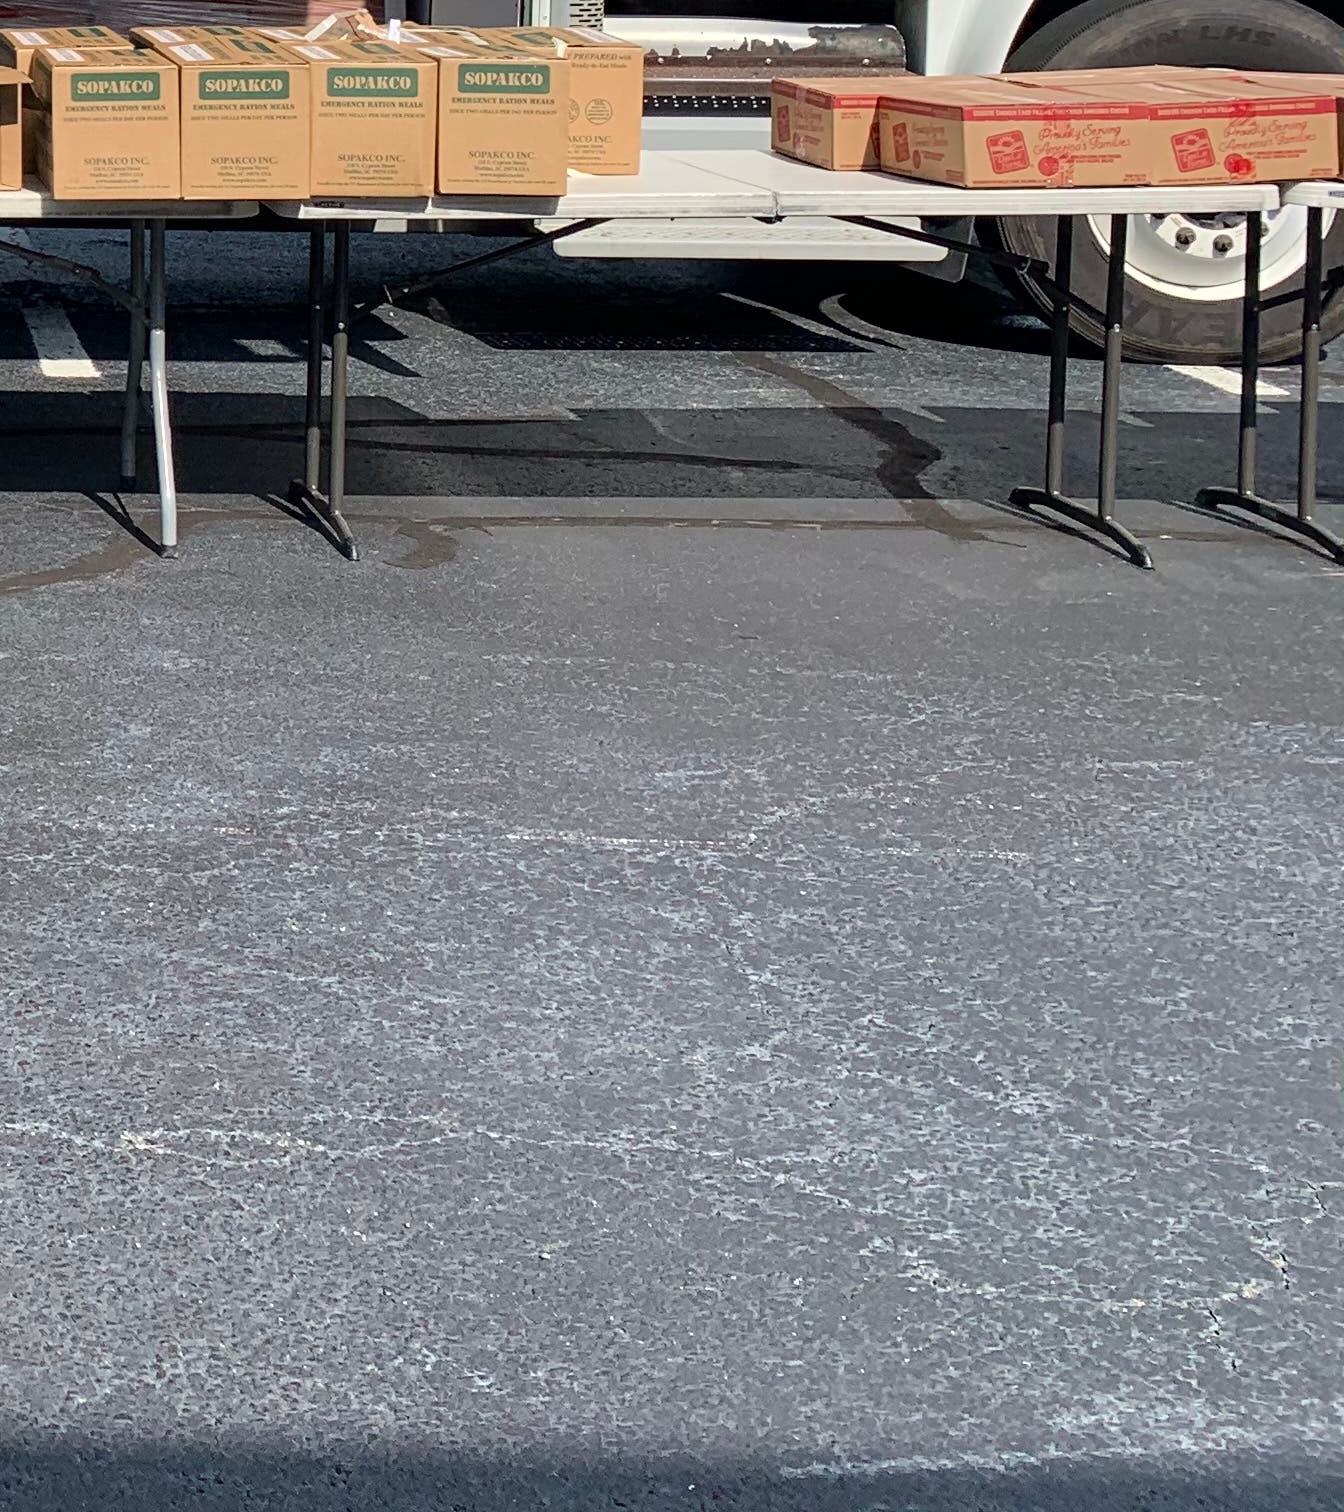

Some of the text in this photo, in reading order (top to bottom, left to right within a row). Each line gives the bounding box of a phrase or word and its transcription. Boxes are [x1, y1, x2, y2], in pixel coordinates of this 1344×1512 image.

[205, 78, 284, 92] SOPAKCO
[333, 75, 411, 90] SOPAKCO
[464, 71, 544, 86] SOPAKCO
[77, 80, 154, 94] SOPAKCO
[1082, 124, 1122, 137] Serving
[83, 157, 129, 165] SOPAKCO
[210, 156, 257, 165] SOPAKCO
[337, 154, 384, 162] SOPAKCO
[468, 150, 515, 159] SOPAKCO
